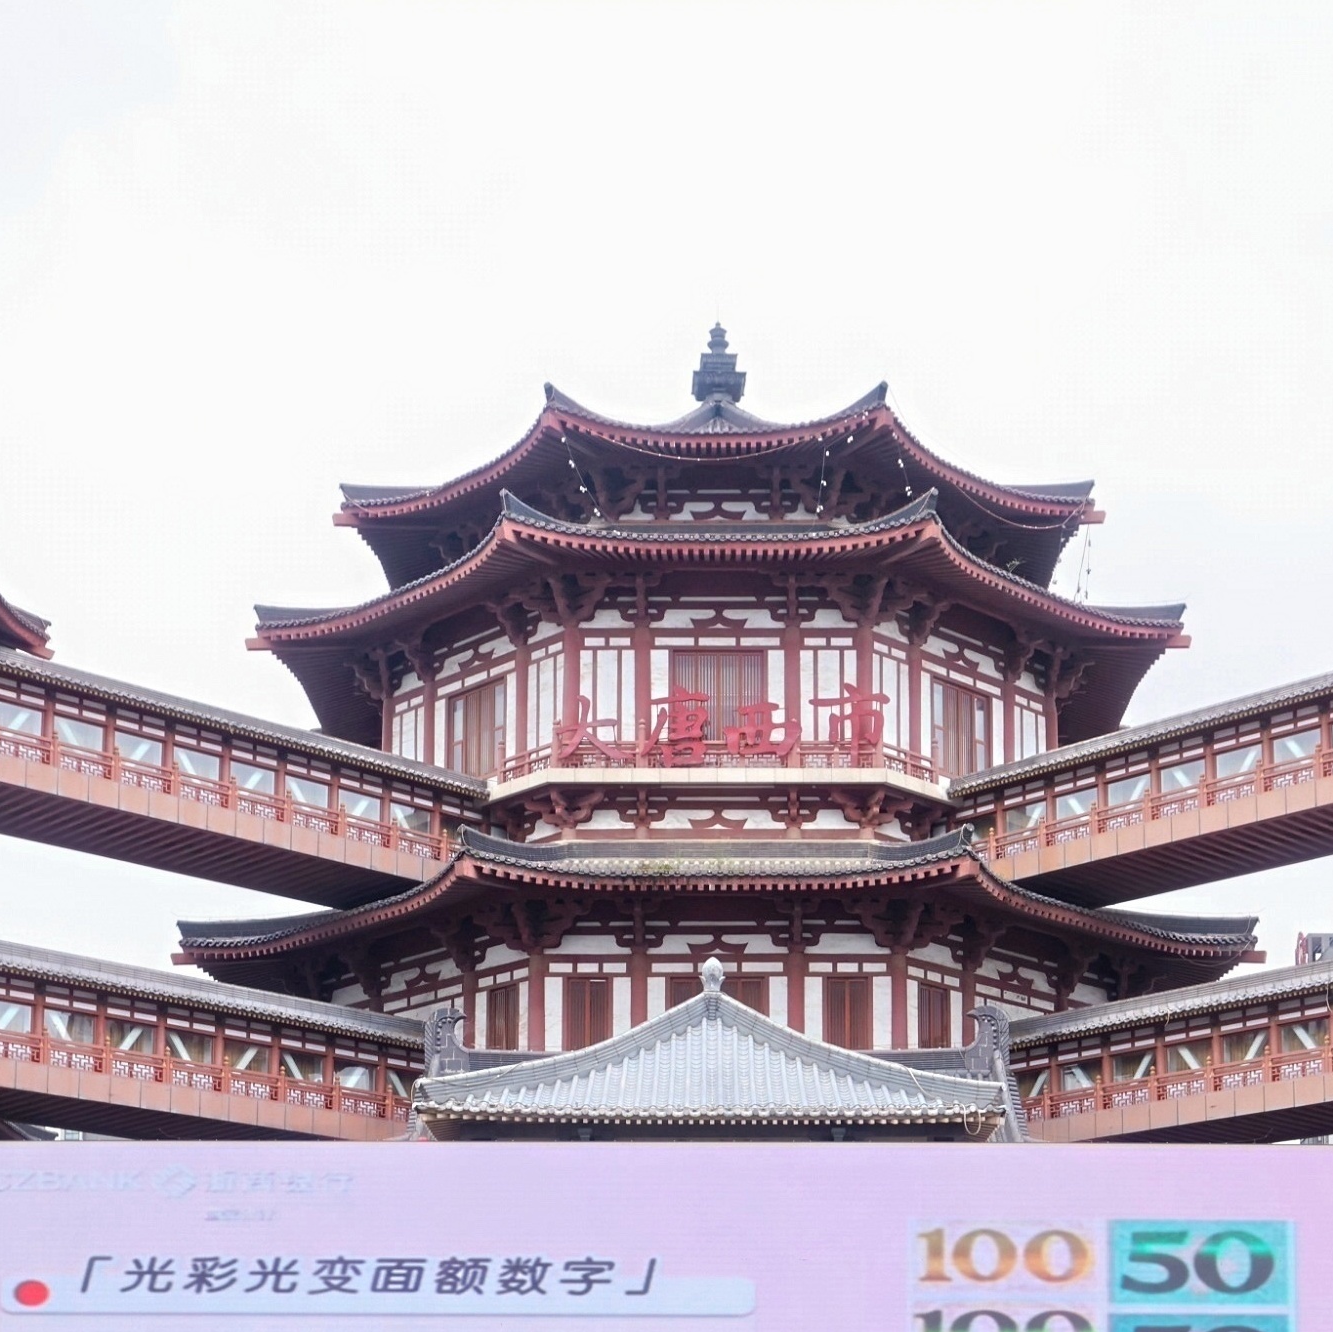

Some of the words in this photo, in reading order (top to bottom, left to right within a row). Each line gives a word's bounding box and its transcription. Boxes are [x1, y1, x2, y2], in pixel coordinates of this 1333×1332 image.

[557, 683, 891, 768] 大唐西市
[80, 1255, 657, 1296] 「光彩光变面额数字」
[917, 1228, 1092, 1284] 100
[1120, 1229, 1275, 1295] 50
